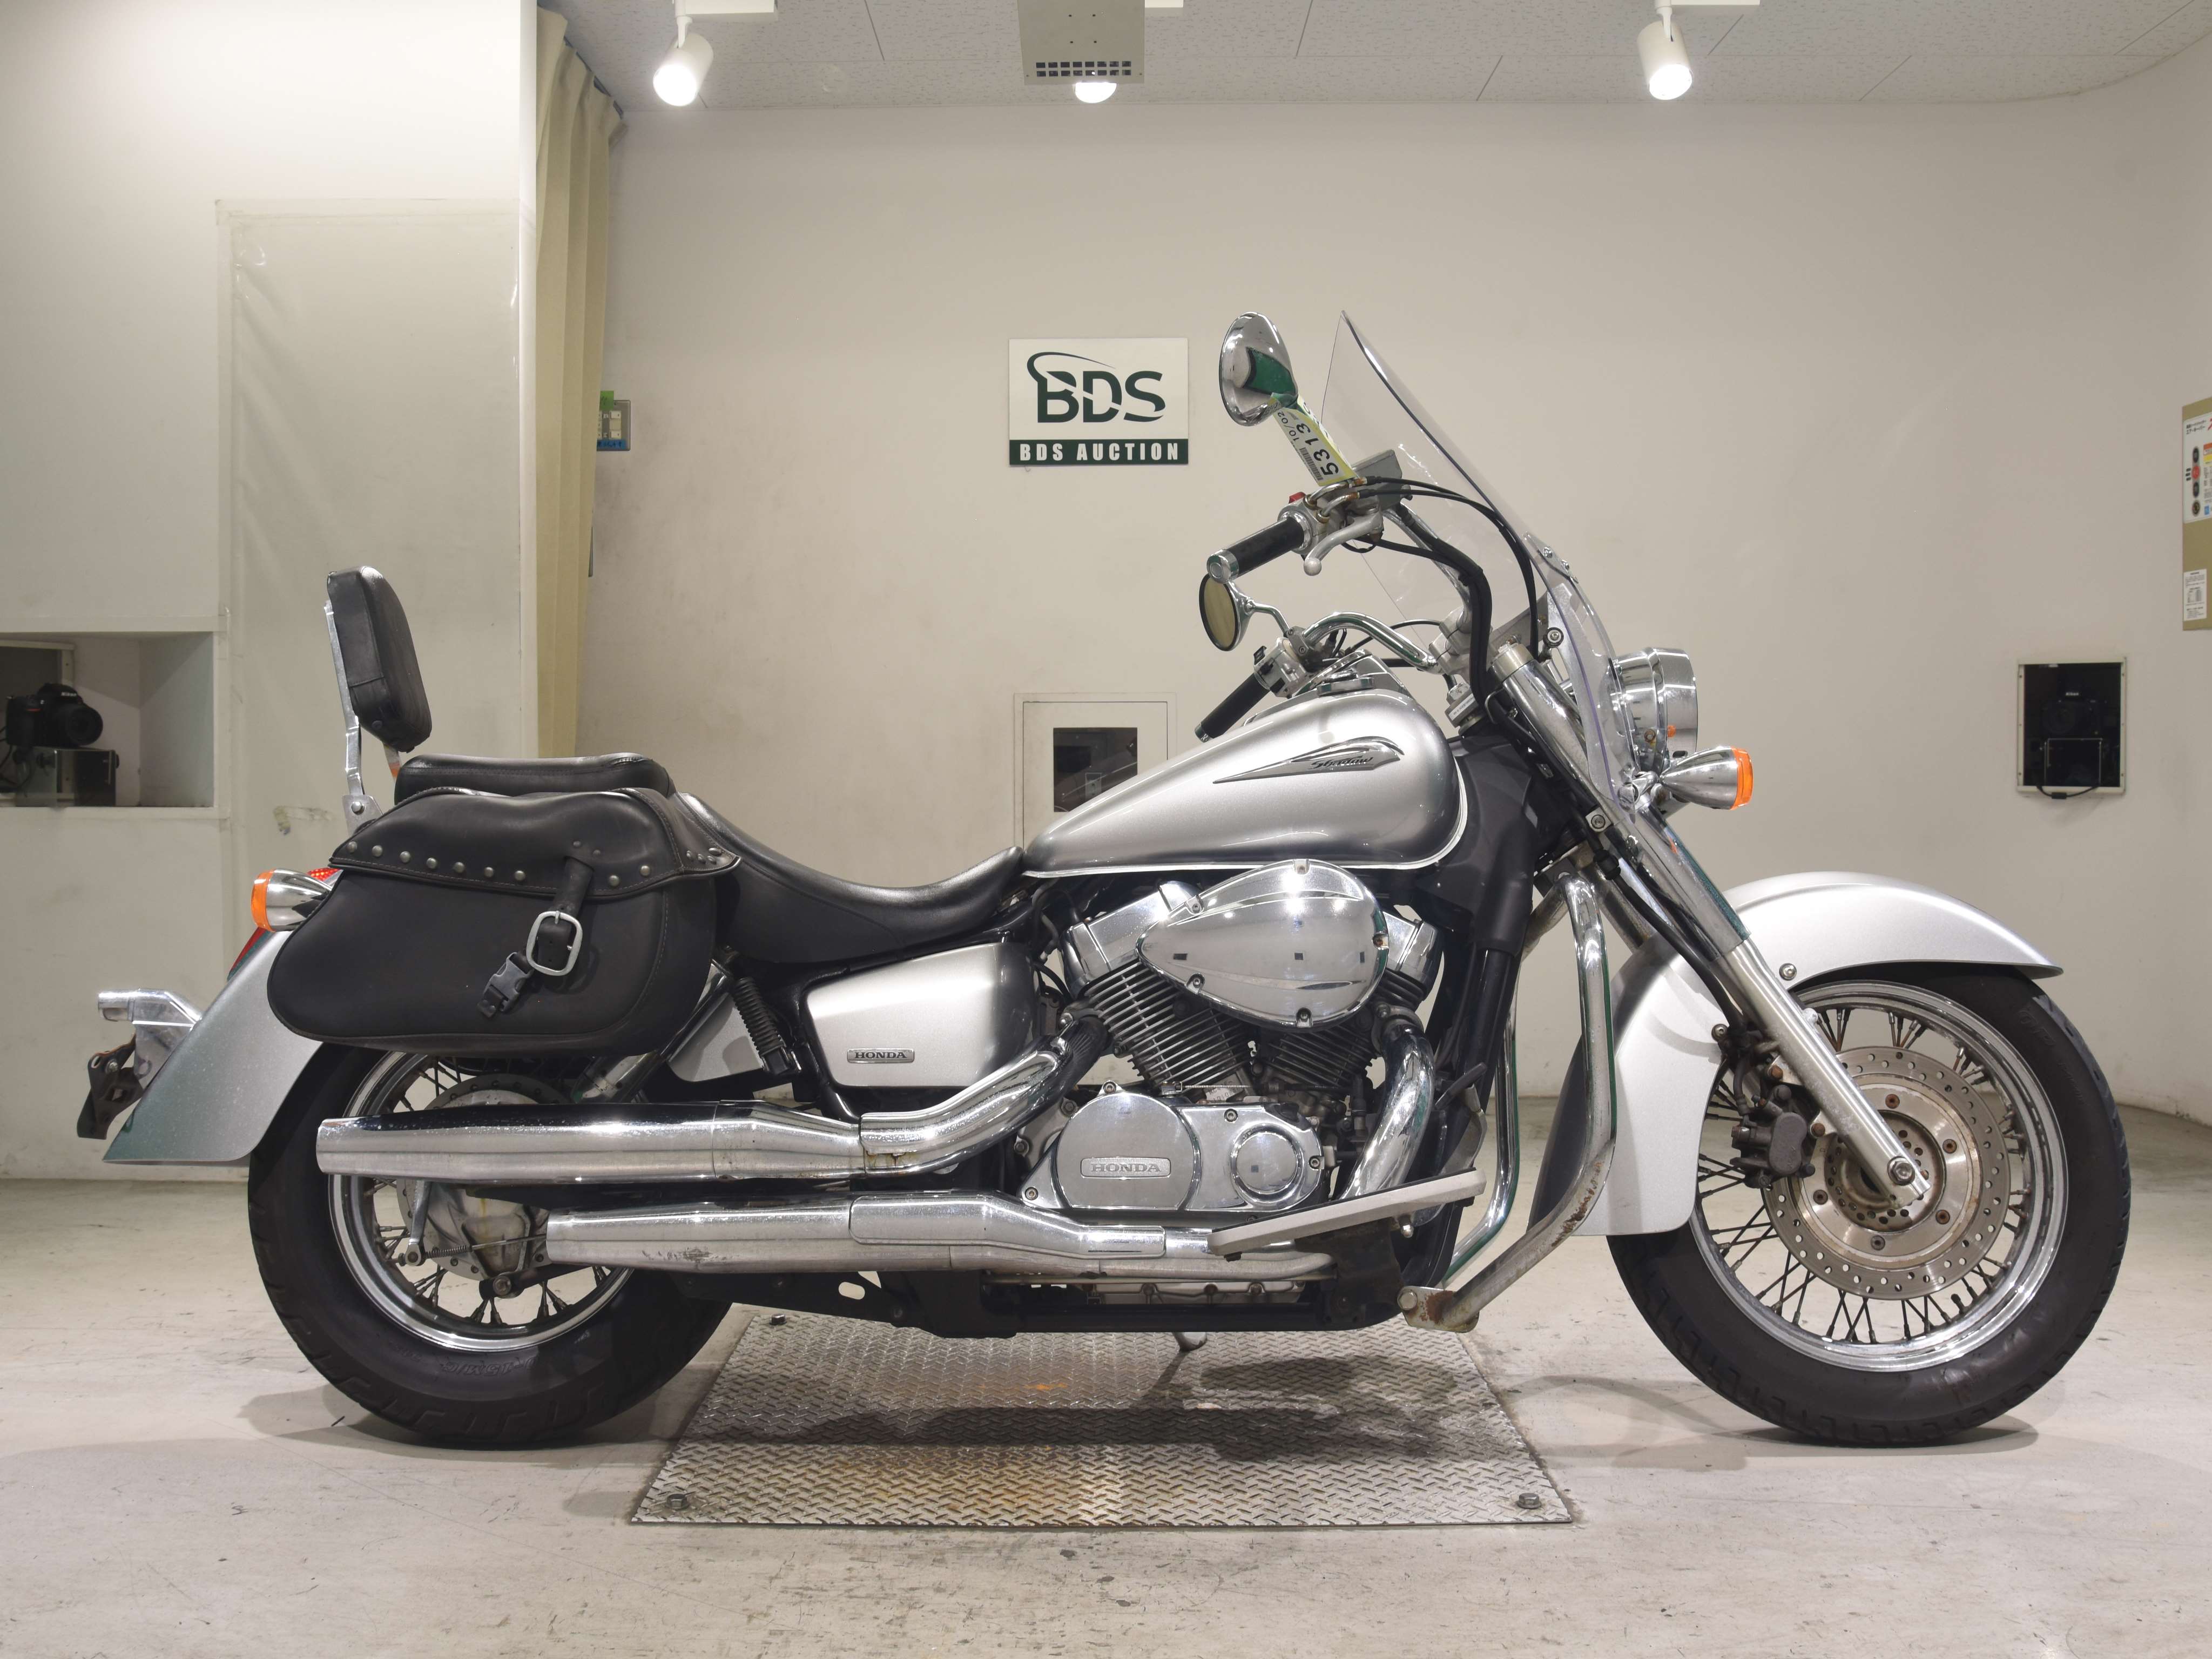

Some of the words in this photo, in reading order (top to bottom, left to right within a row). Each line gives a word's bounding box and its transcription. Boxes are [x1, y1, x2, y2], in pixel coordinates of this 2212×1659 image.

[1027, 352, 1166, 423] BDS
[1277, 411, 1300, 442] 10/02
[1020, 443, 1063, 461] BDS
[1076, 443, 1178, 461] AUCTION
[1296, 422, 1339, 476] 5313
[1090, 1163, 1161, 1172] HONDA
